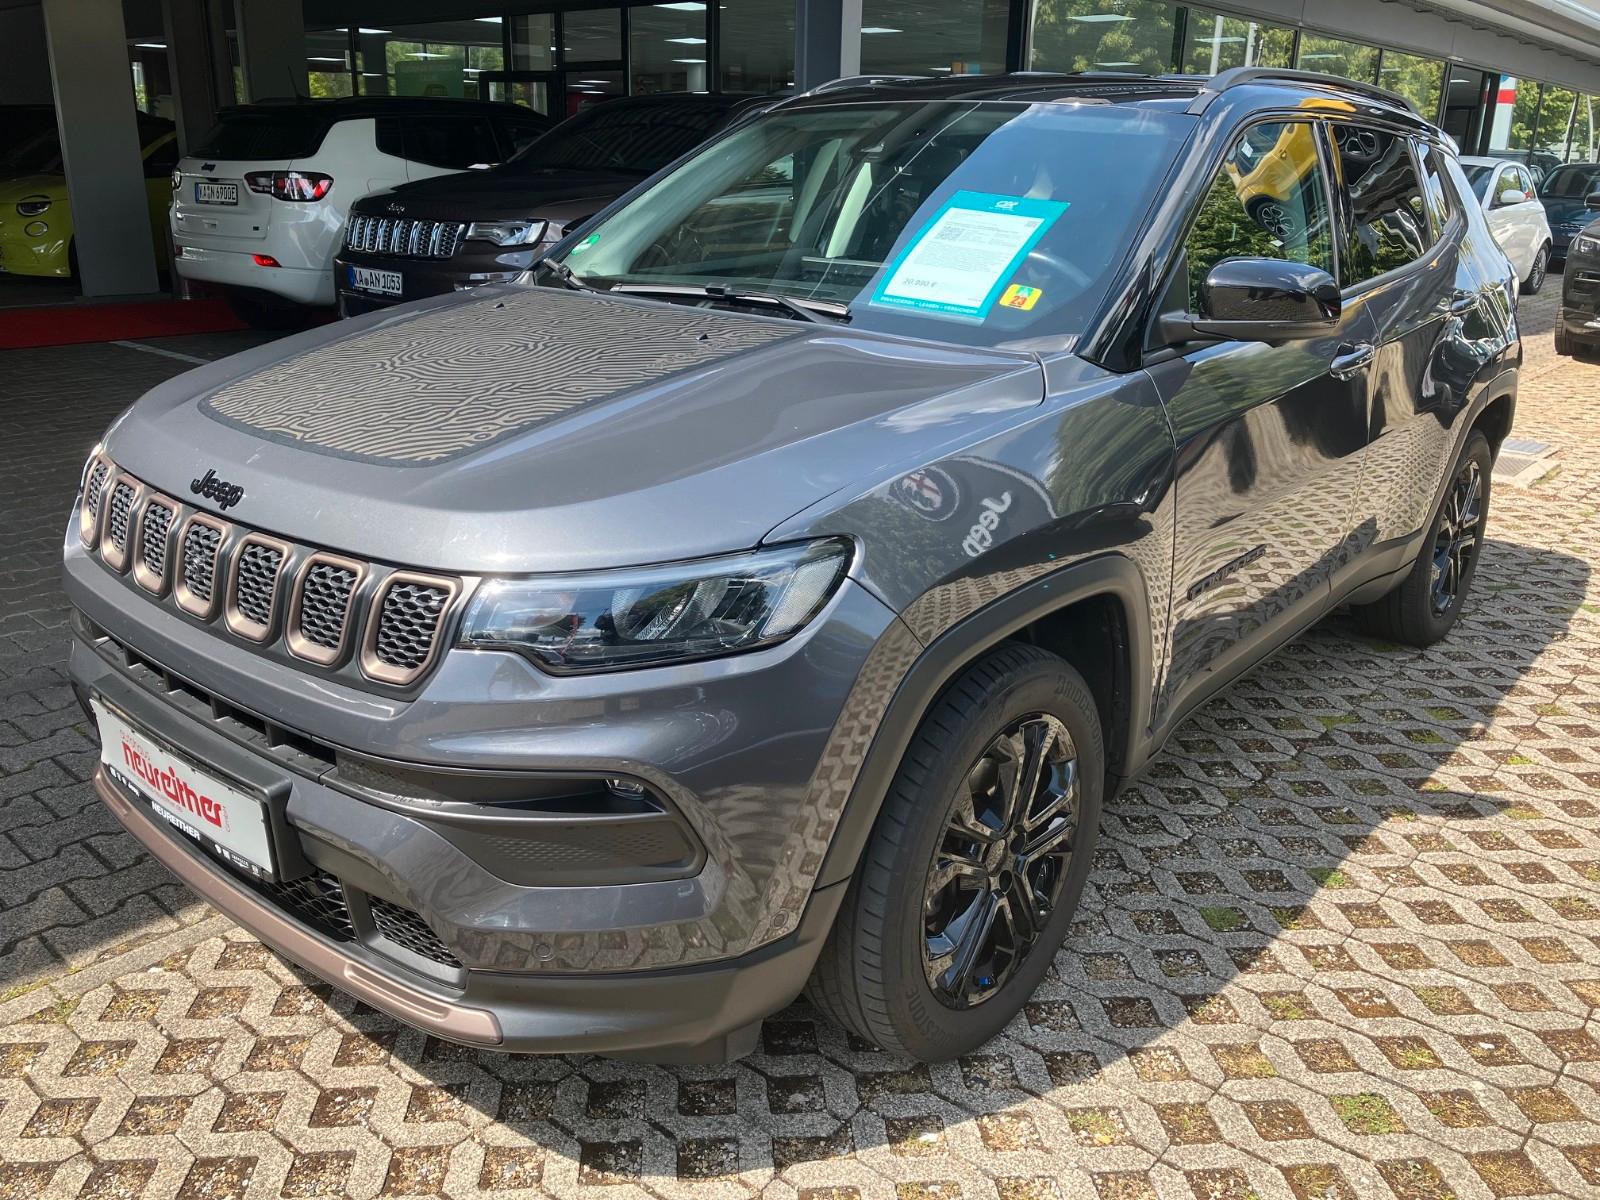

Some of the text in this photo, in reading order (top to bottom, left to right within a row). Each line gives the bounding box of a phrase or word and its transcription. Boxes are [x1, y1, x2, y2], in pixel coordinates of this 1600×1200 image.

[354, 268, 364, 286] KA
[369, 271, 380, 288] AN
[381, 273, 401, 292] 1053
[1010, 295, 1027, 306] 23
[190, 468, 245, 511] Jeep
[151, 800, 201, 841] NEUREITHER
